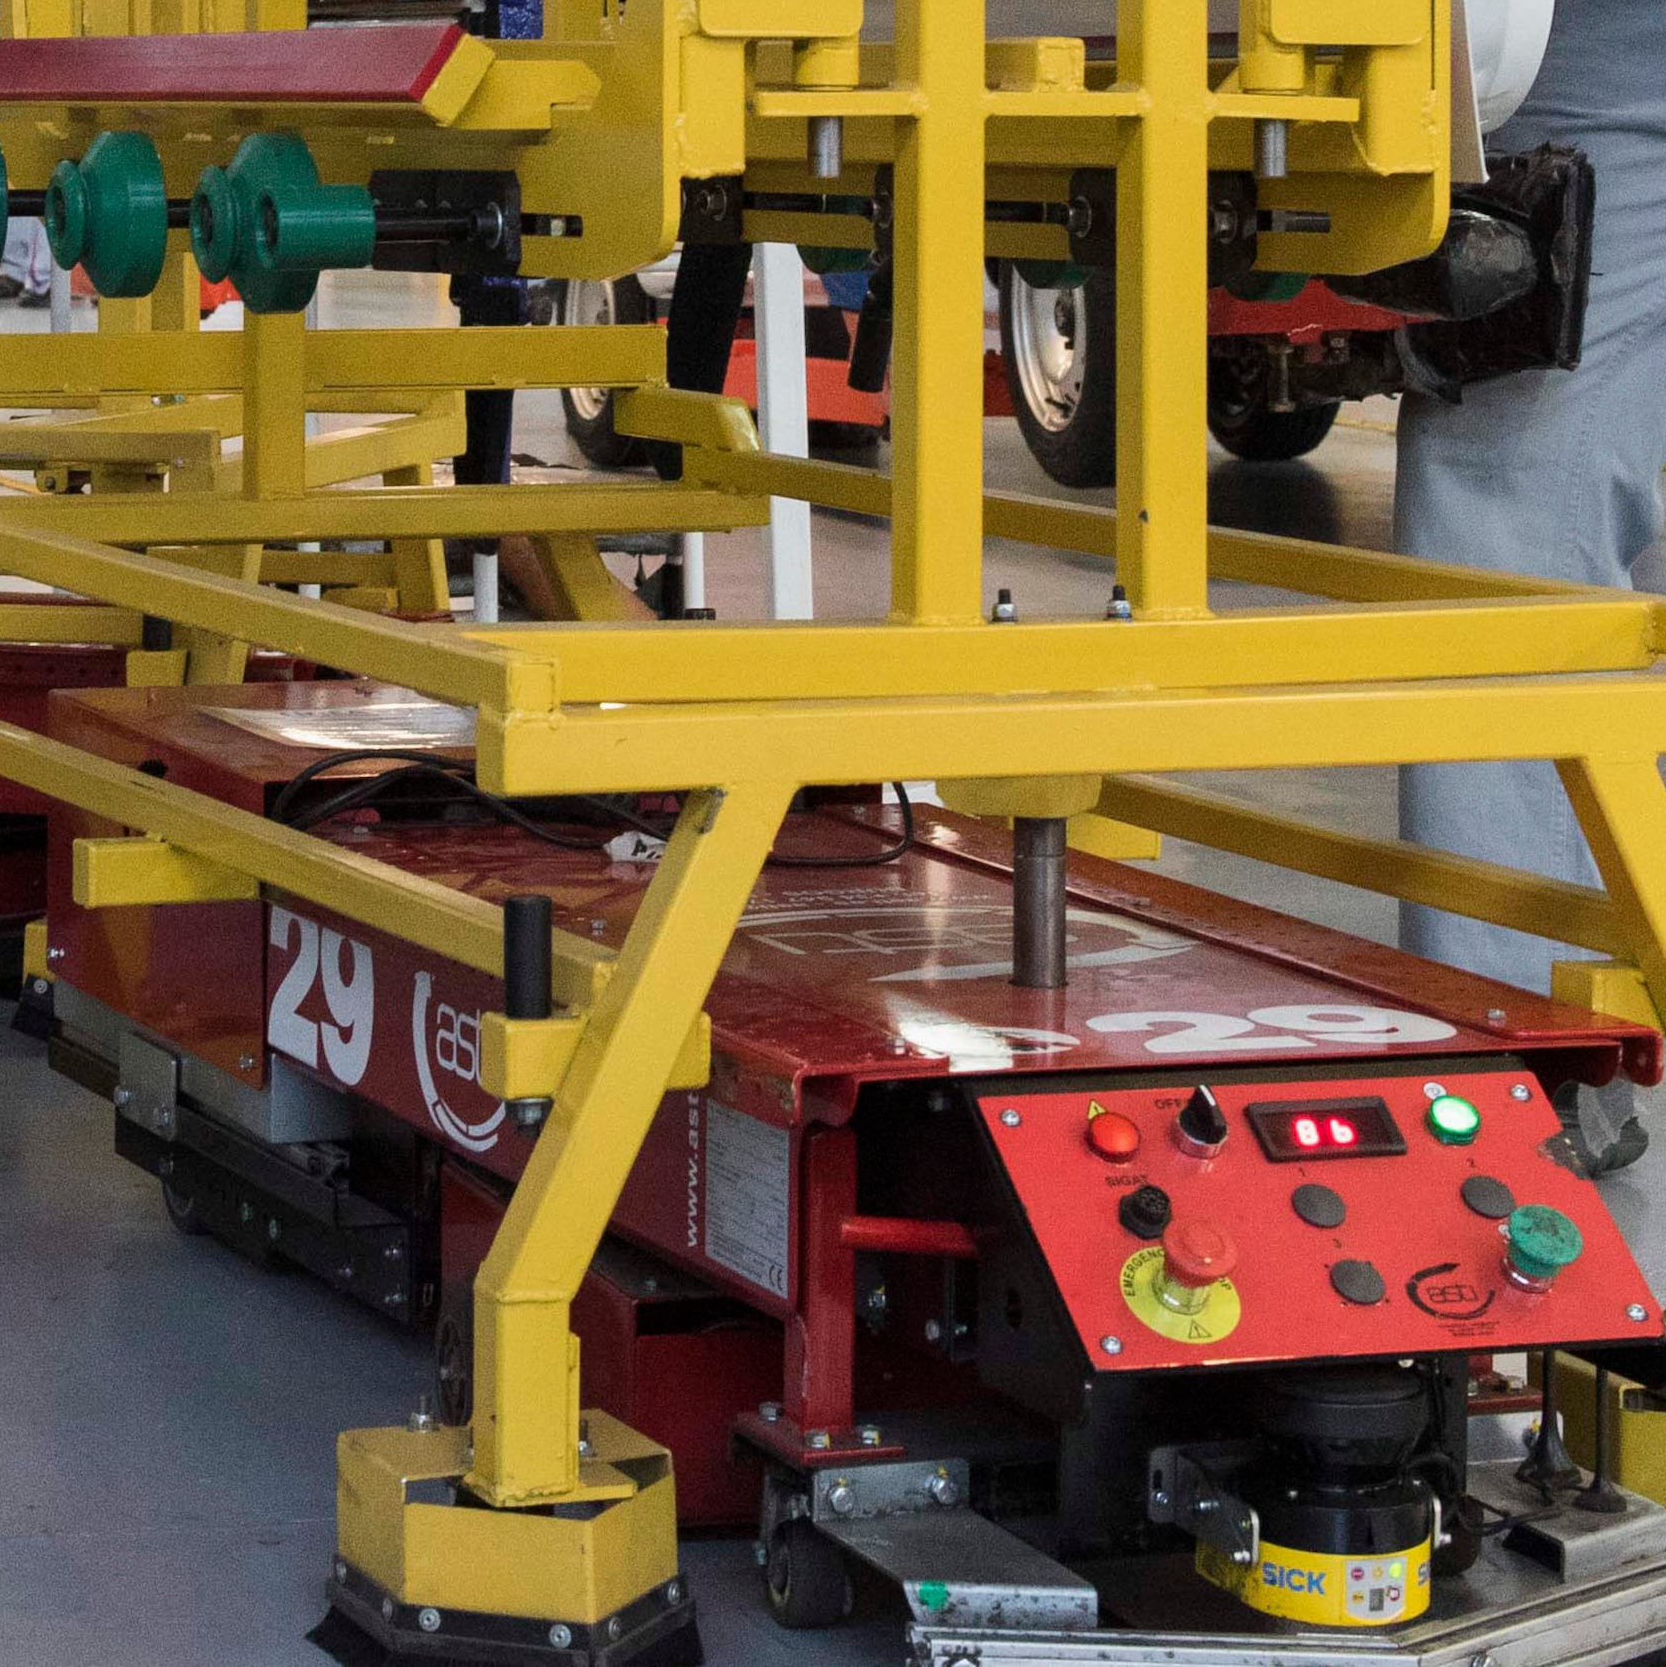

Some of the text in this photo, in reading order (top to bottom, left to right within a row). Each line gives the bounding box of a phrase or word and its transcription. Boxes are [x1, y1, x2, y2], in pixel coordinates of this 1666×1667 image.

[267, 905, 482, 1088] 29 ast
[1085, 1004, 1458, 1054] 29
[687, 1091, 700, 1247] www.ast
[1124, 1247, 1165, 1298] EMERGENC
[1426, 1283, 1479, 1304] asti
[1261, 1561, 1326, 1596] SICK
